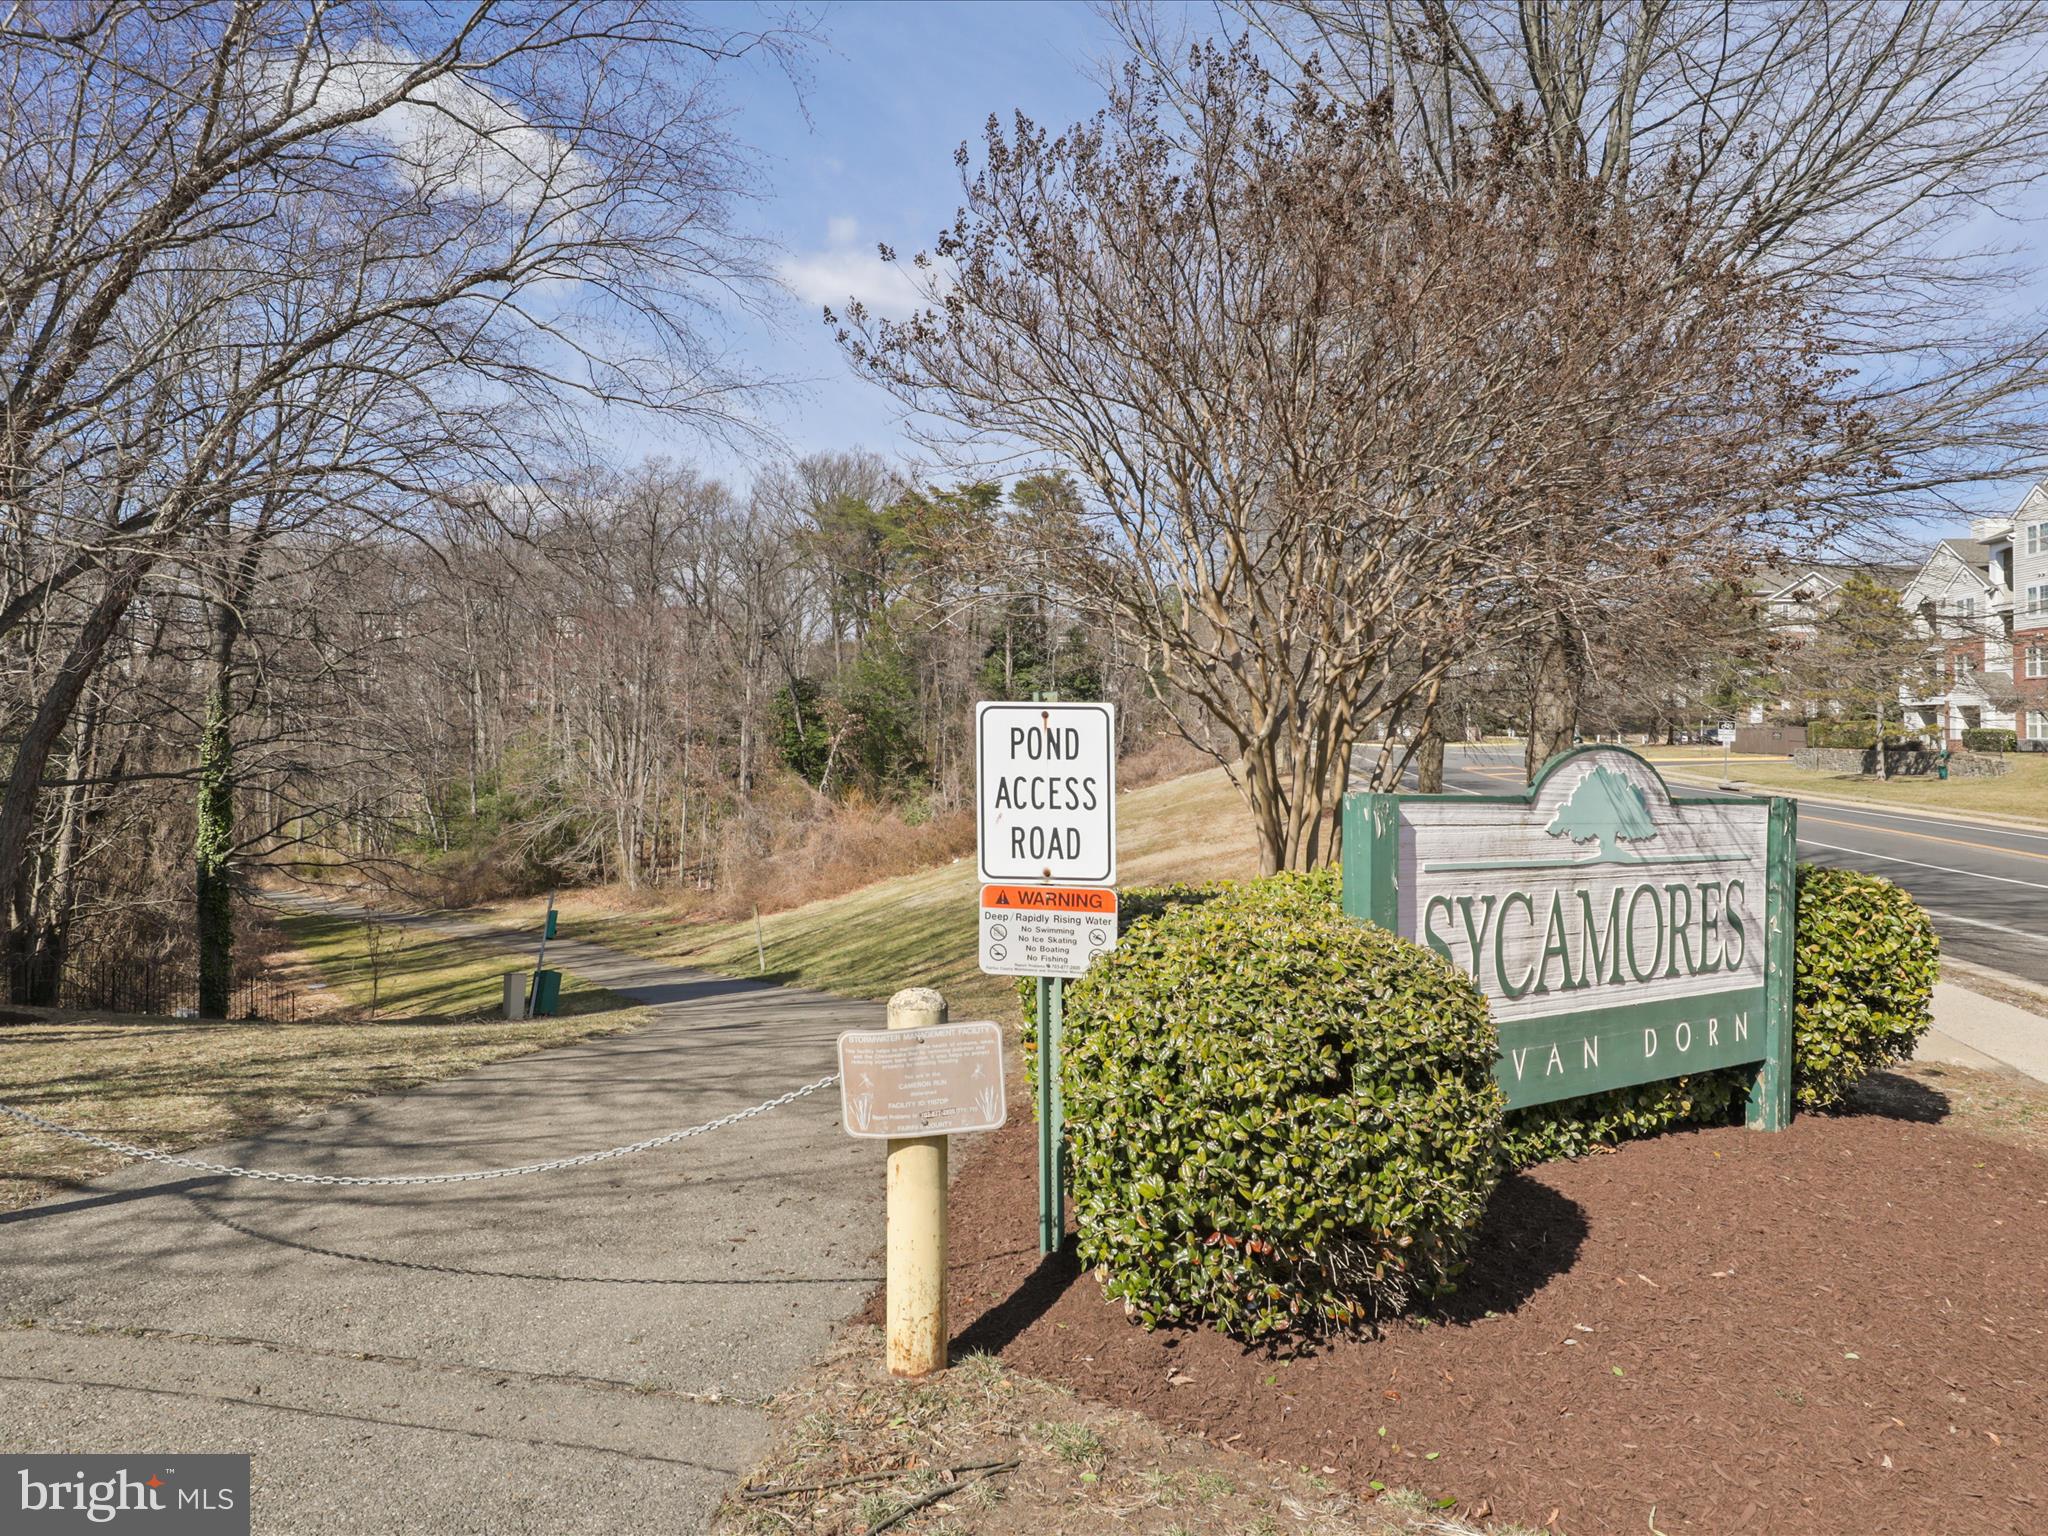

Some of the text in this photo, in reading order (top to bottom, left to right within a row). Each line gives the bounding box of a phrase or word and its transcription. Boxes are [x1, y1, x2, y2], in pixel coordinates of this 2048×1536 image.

[1010, 727, 1080, 760] POND
[995, 776, 1097, 811] ACCESS
[1011, 826, 1081, 860] ROAD
[1018, 890, 1102, 909] WARNING
[1053, 914, 1081, 926] Rising
[1085, 915, 1112, 926] Water
[1021, 925, 1075, 935] No Swimming
[1424, 879, 1746, 999] SYCAMORES
[1018, 935, 1029, 943] No
[1047, 936, 1078, 945] Skating
[1039, 945, 1070, 954] Boating
[1026, 954, 1069, 964] No Fishing
[1512, 1012, 1748, 1081] VAN DORN
